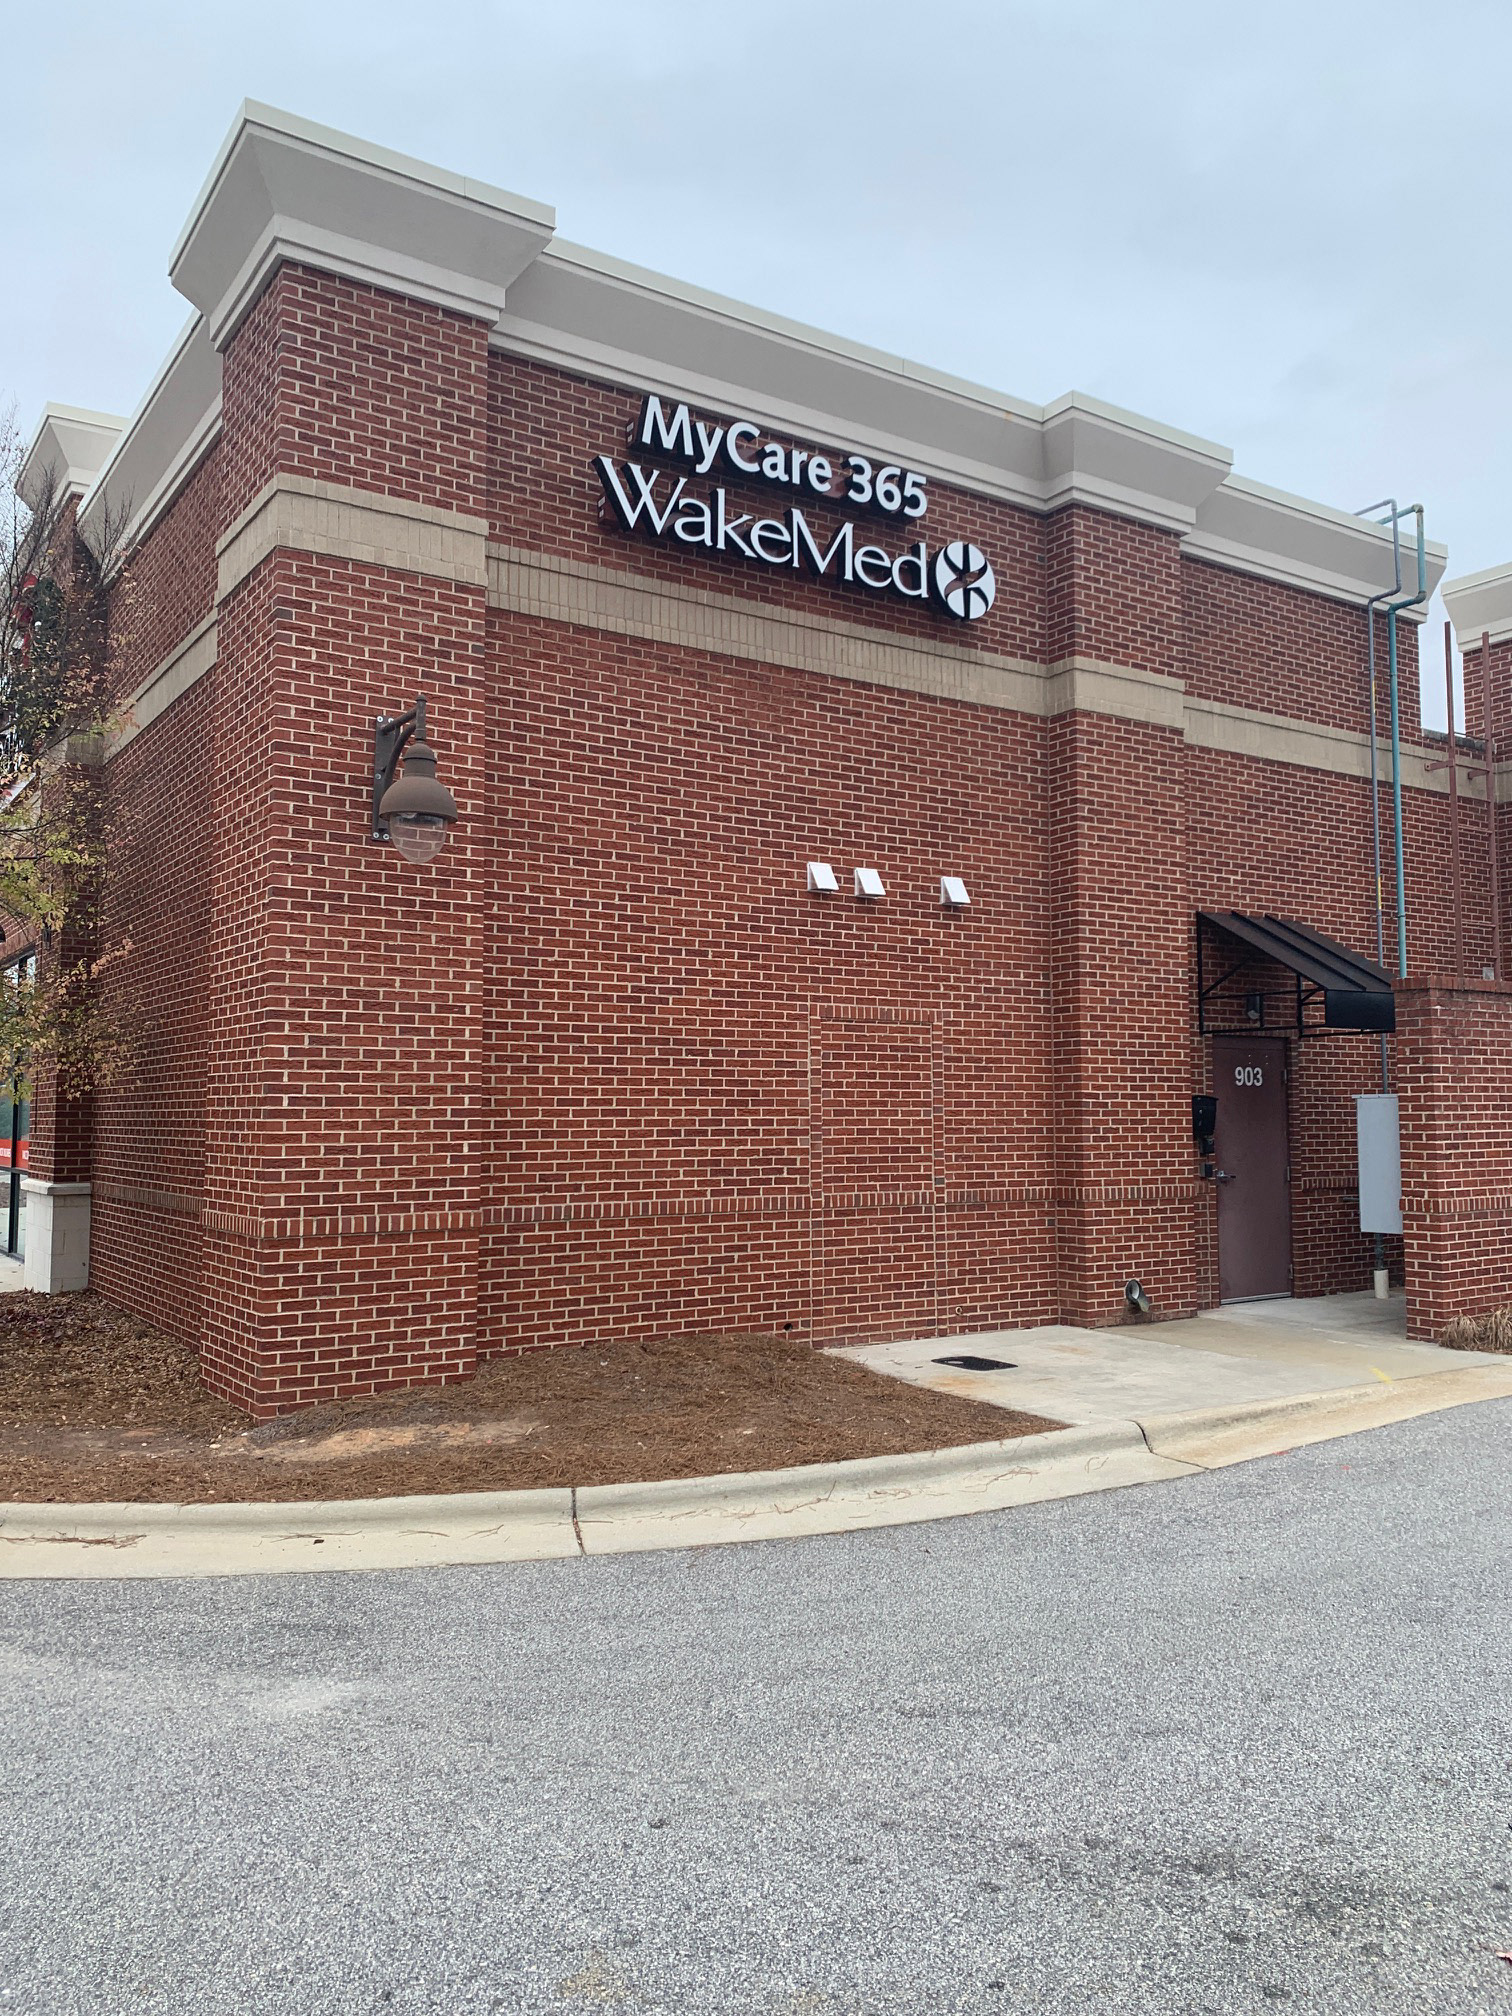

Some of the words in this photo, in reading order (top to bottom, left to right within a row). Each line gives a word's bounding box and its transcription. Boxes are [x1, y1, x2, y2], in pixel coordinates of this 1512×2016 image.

[641, 395, 832, 492] MyCare
[847, 456, 928, 518] 365
[599, 456, 929, 598] WakeMed
[1235, 1066, 1263, 1087] 903
